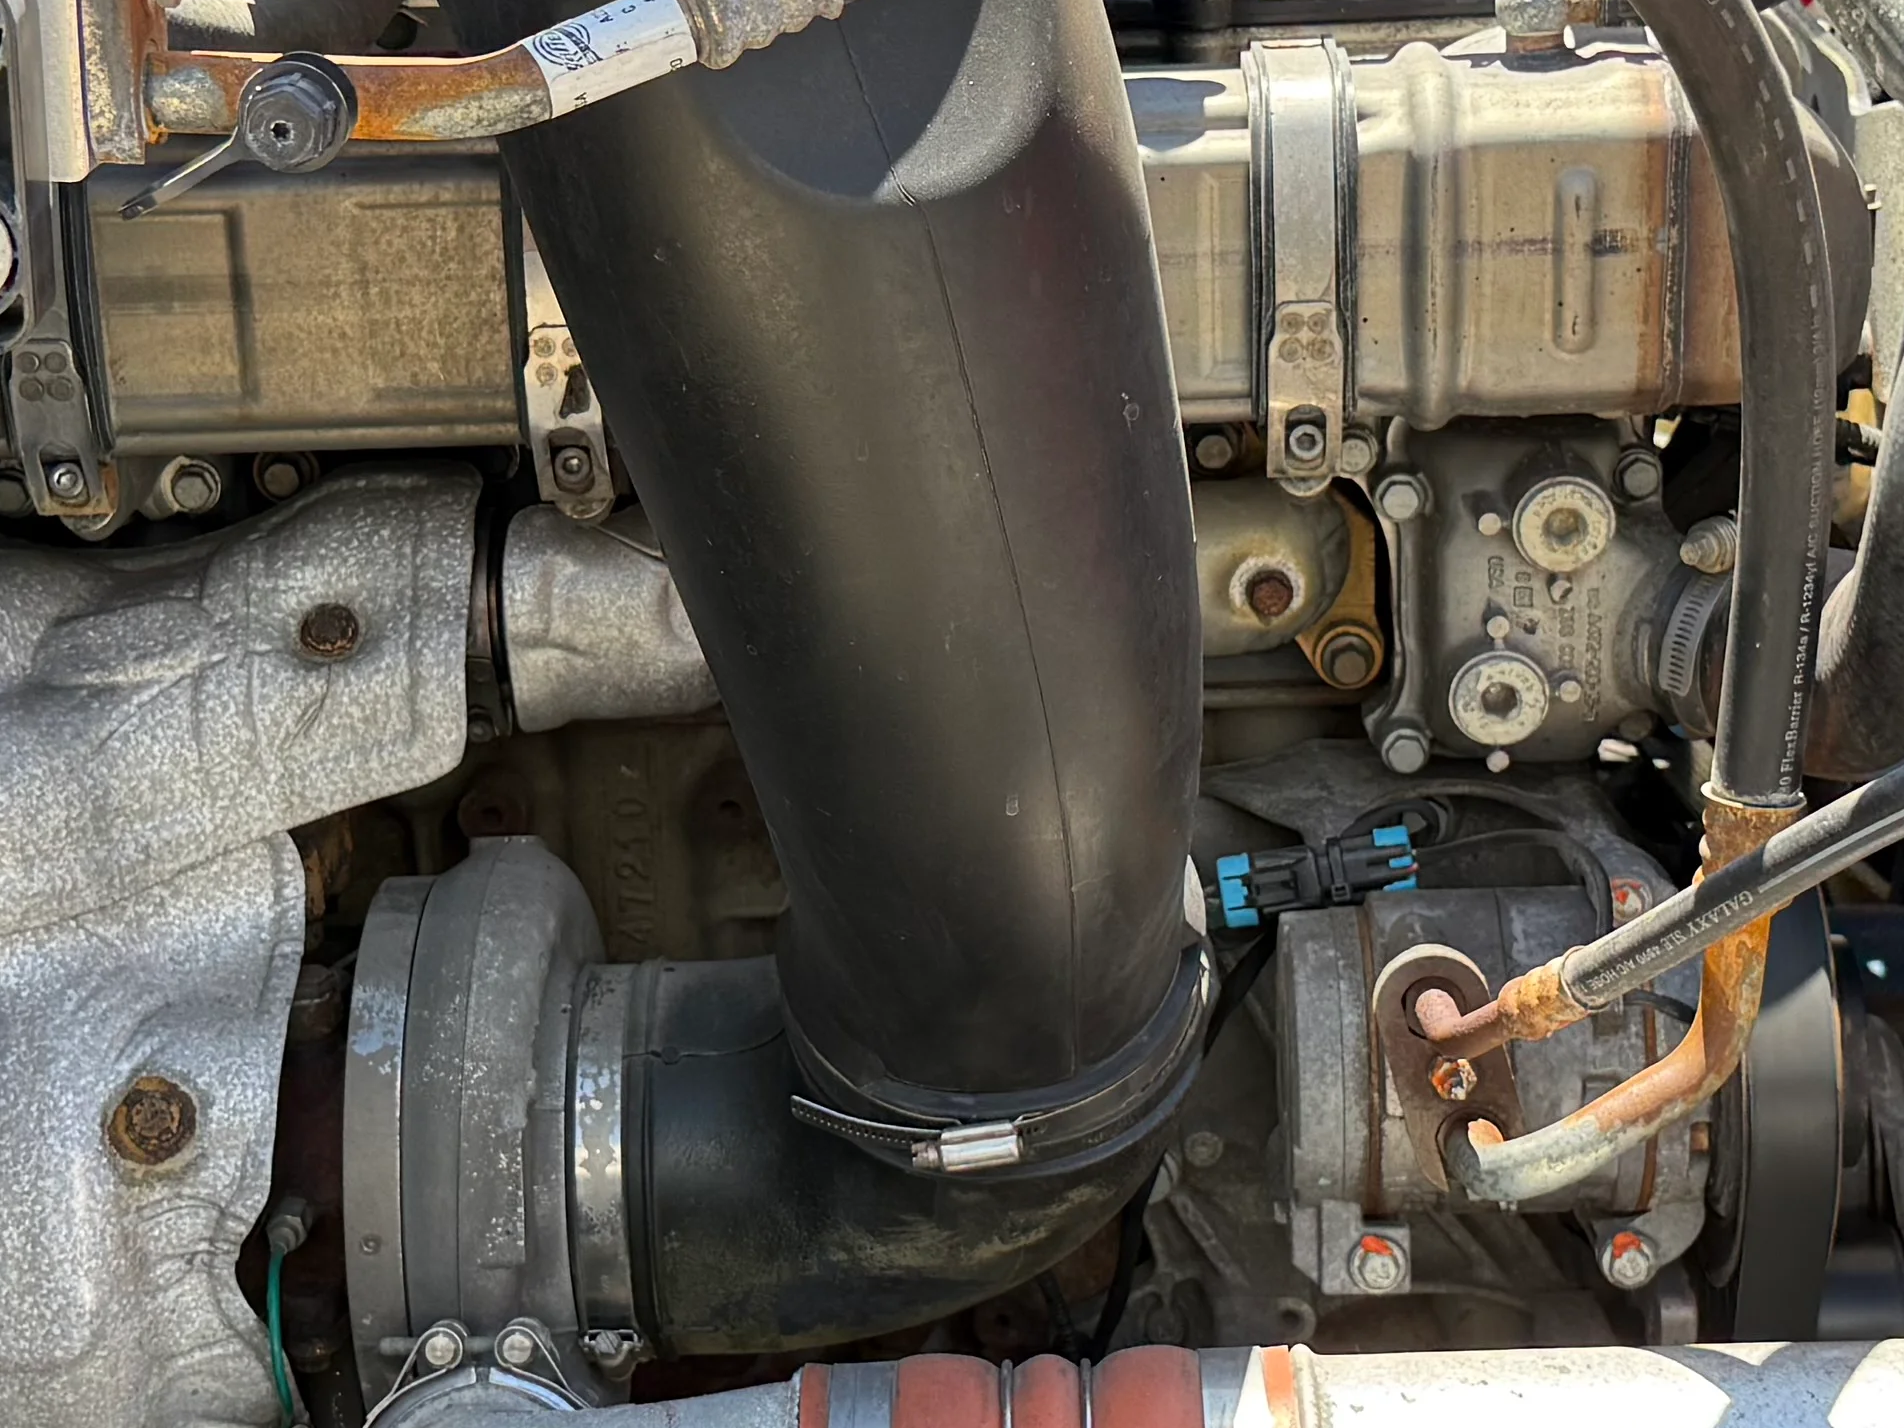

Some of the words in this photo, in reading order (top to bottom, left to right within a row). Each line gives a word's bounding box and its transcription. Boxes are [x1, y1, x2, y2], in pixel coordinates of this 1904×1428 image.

[1793, 636, 1809, 685] R-134a
[1689, 889, 1754, 938] GALAXY
[1659, 928, 1687, 952] SLE
